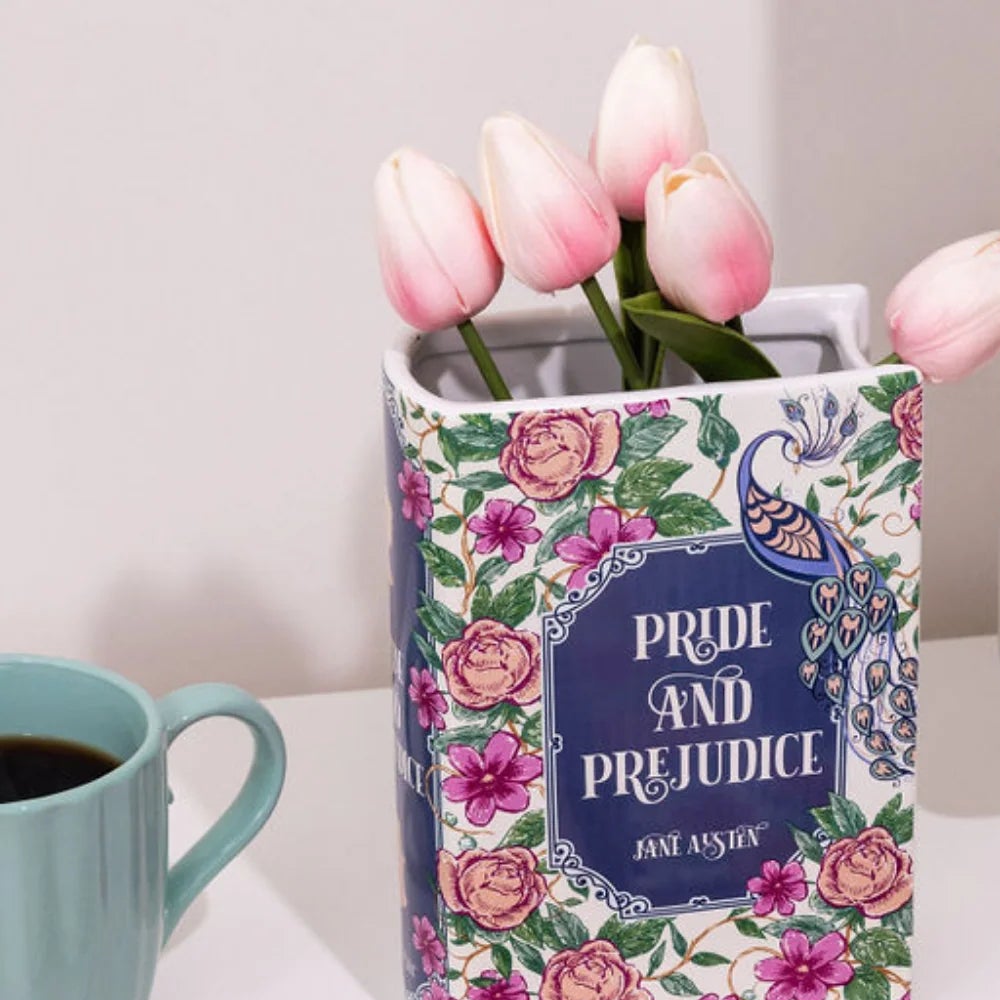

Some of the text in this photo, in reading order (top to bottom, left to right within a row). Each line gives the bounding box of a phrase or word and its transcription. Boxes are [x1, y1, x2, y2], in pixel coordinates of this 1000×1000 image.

[632, 601, 772, 665] PRIDE
[648, 665, 752, 732] AND
[581, 730, 823, 804] PREJUDICE
[632, 821, 769, 861] JANE AUSTEN
